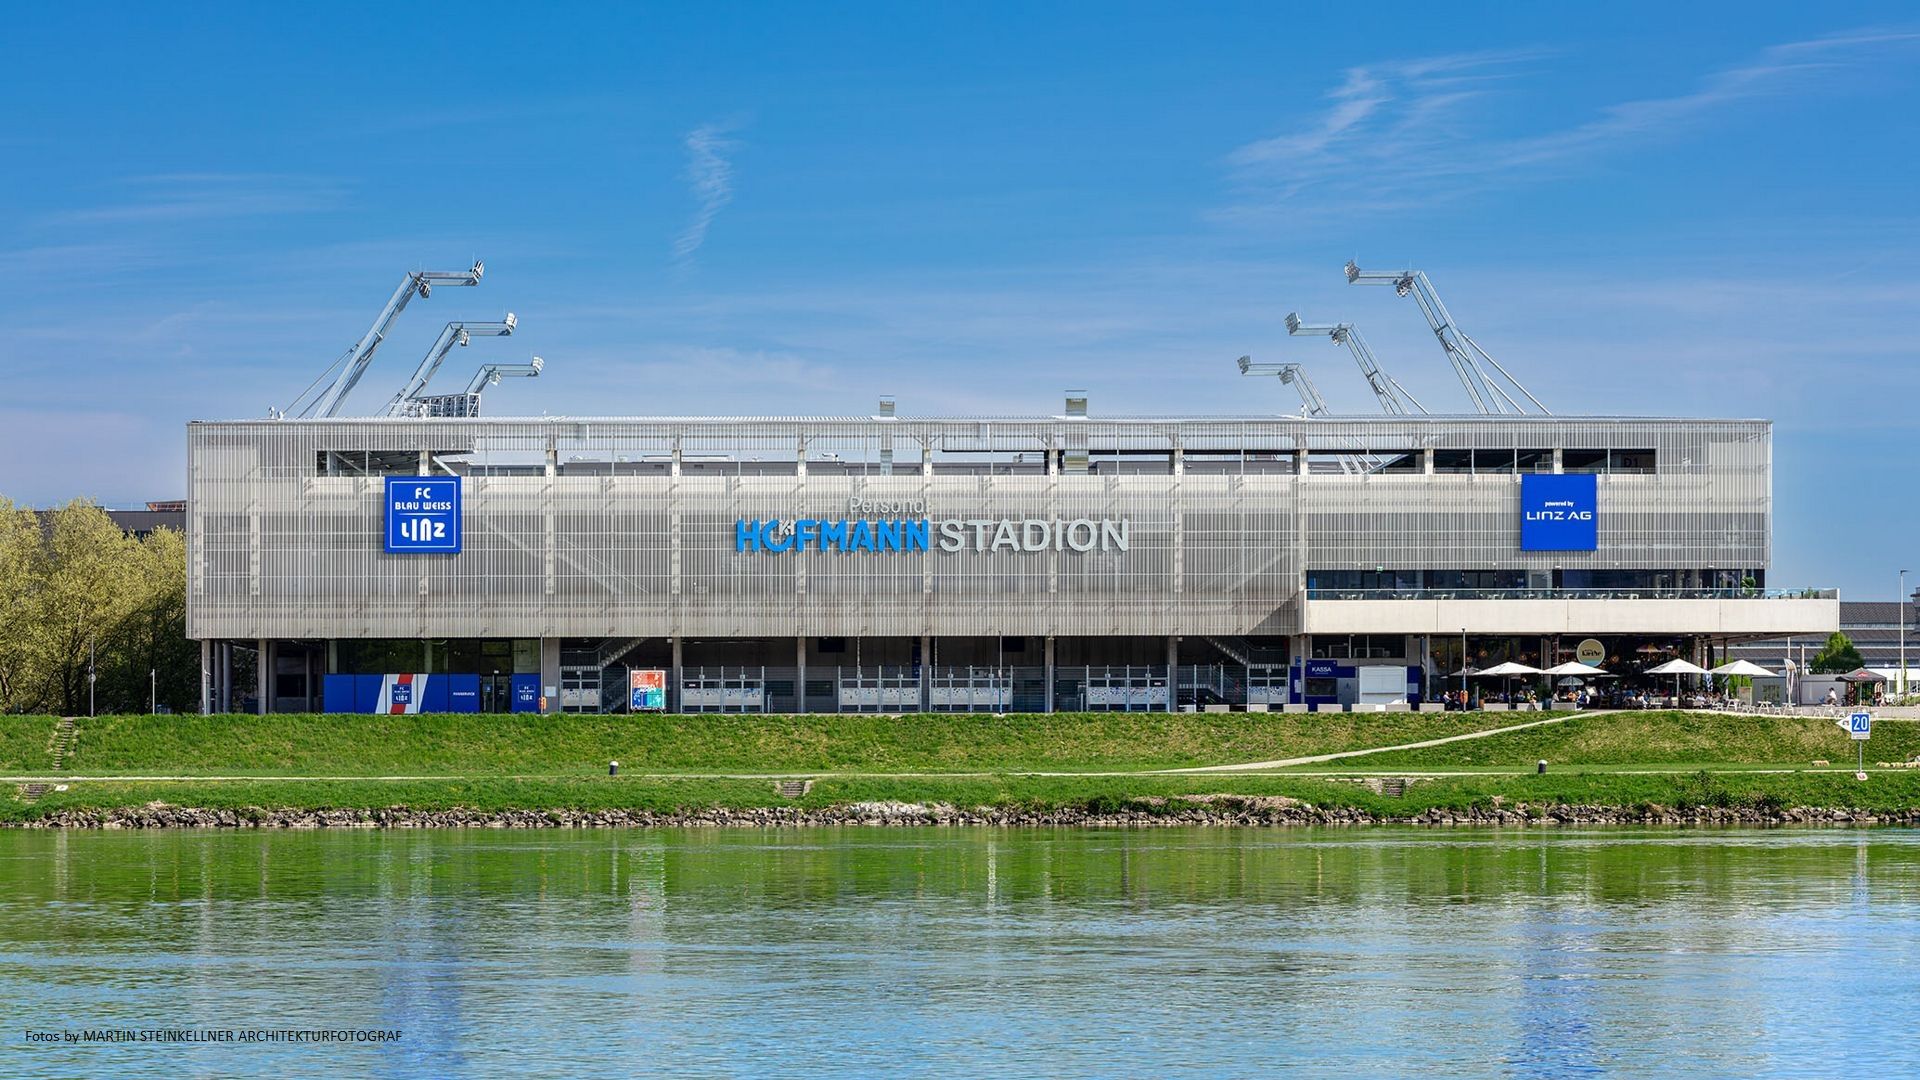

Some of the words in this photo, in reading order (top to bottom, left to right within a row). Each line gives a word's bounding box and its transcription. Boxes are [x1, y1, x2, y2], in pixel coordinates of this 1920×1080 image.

[415, 487, 431, 499] FC
[394, 501, 419, 510] BLAU
[422, 501, 452, 510] WEISS
[1526, 511, 1564, 520] LINZ
[1567, 511, 1592, 520] AG
[401, 518, 446, 541] LINZ
[736, 519, 929, 552] HOFMANN
[939, 518, 1129, 552] STADION
[1853, 716, 1868, 730] 20
